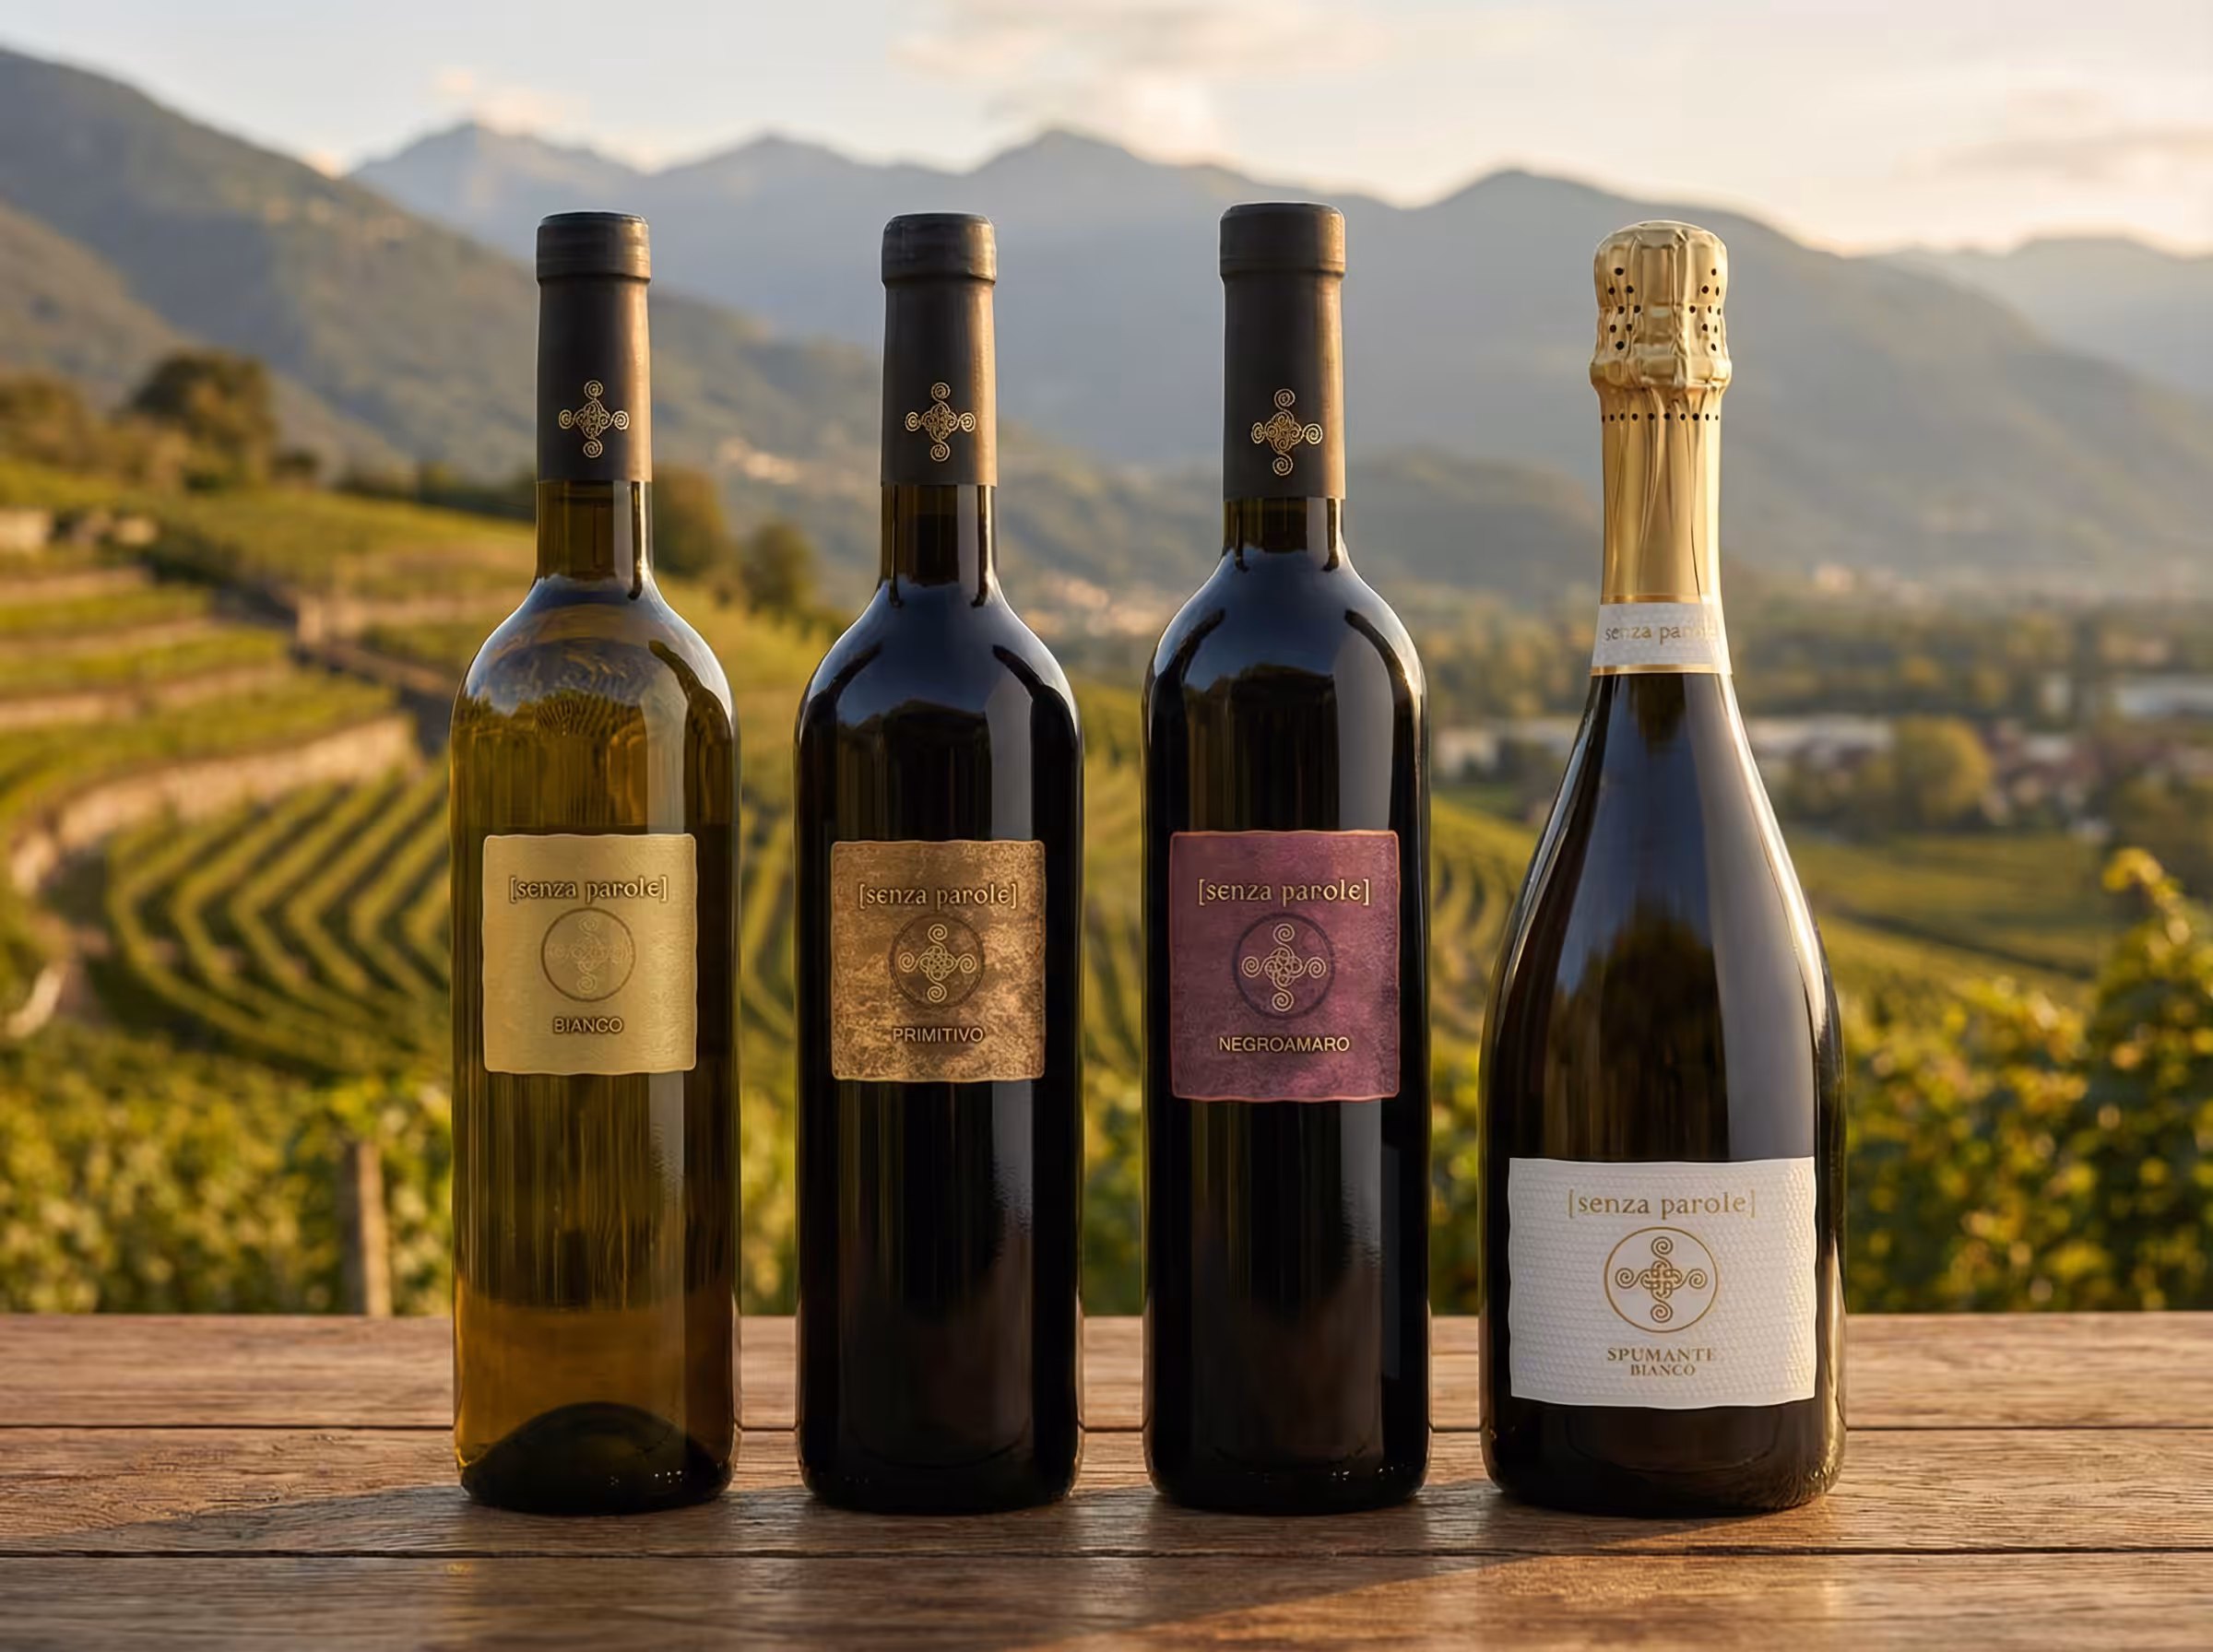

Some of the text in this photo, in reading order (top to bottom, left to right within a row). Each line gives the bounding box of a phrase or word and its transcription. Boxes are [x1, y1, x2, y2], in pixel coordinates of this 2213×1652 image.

[1605, 626, 1720, 644] senza par
[893, 1027, 984, 1043] PRIMITIVO
[1219, 1036, 1350, 1053] NEGROAMARO
[1629, 1363, 1696, 1376] BIANCO
